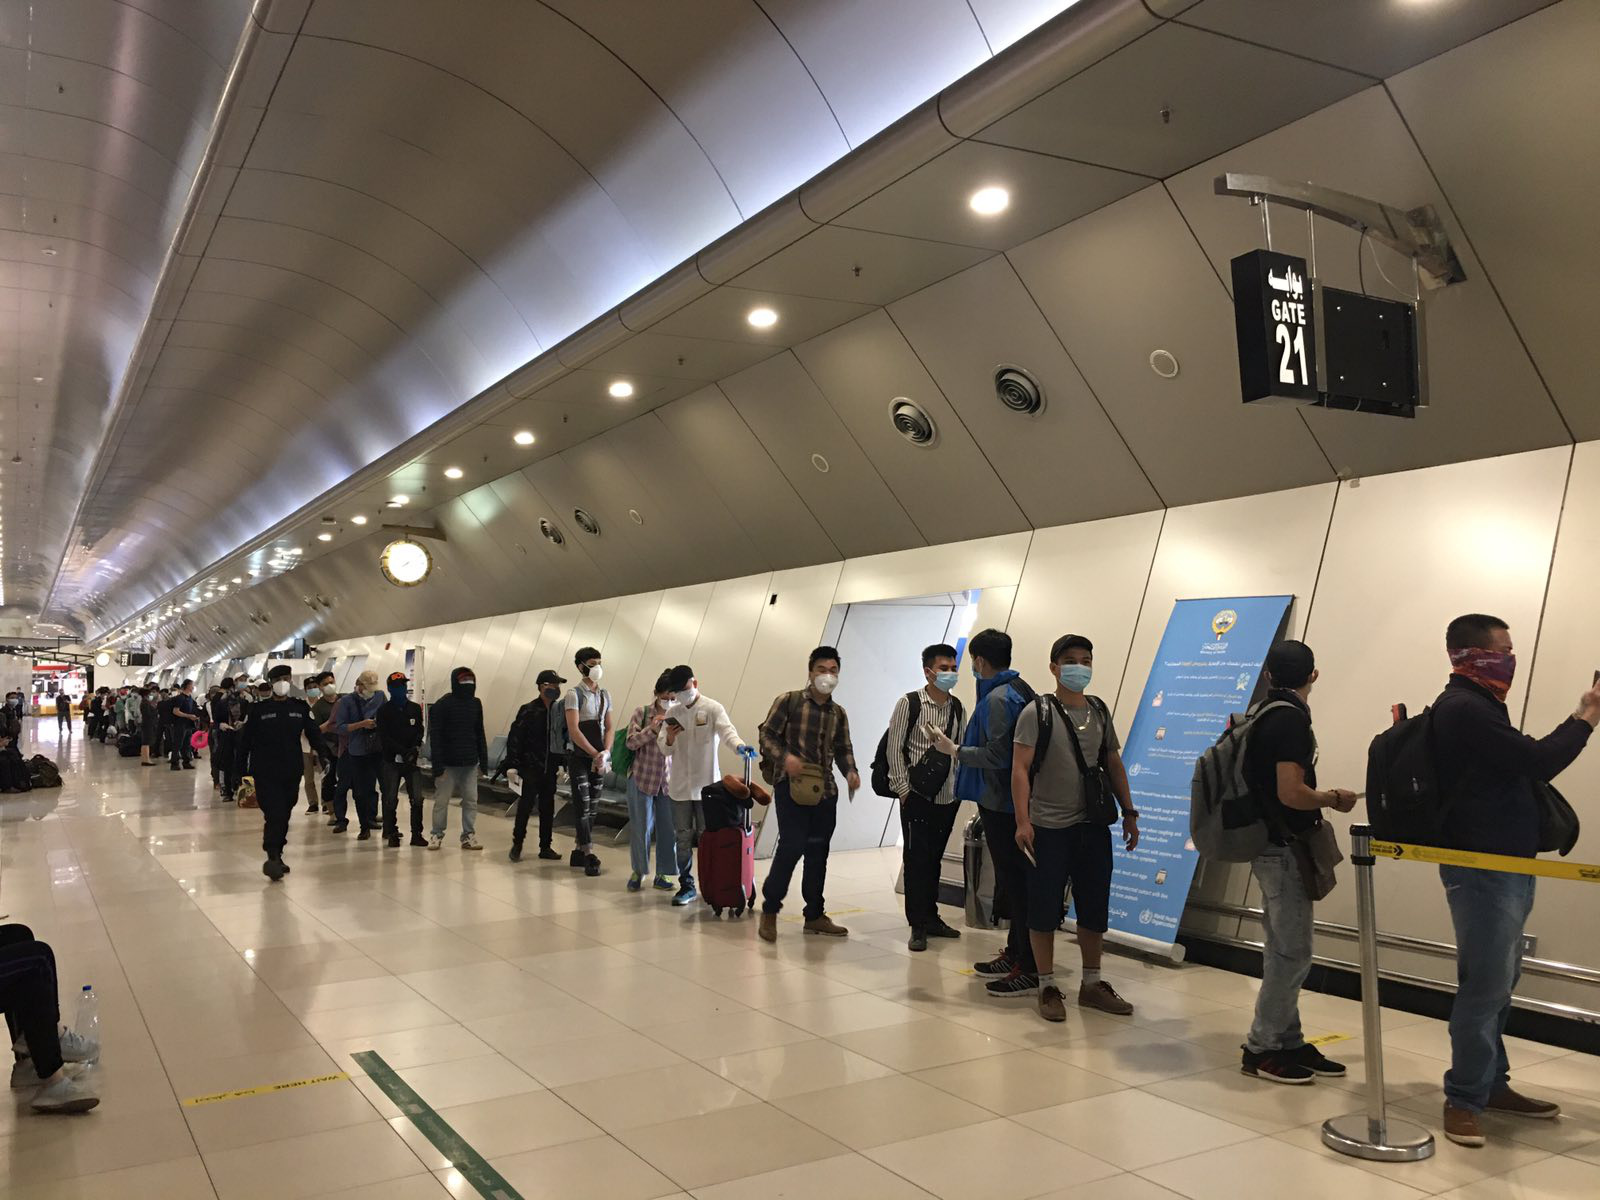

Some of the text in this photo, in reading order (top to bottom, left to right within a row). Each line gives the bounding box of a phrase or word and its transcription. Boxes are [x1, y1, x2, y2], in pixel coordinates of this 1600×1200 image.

[1271, 299, 1306, 325] GATE
[1275, 323, 1308, 386] 21
[273, 1075, 338, 1089] WAIT HERE
